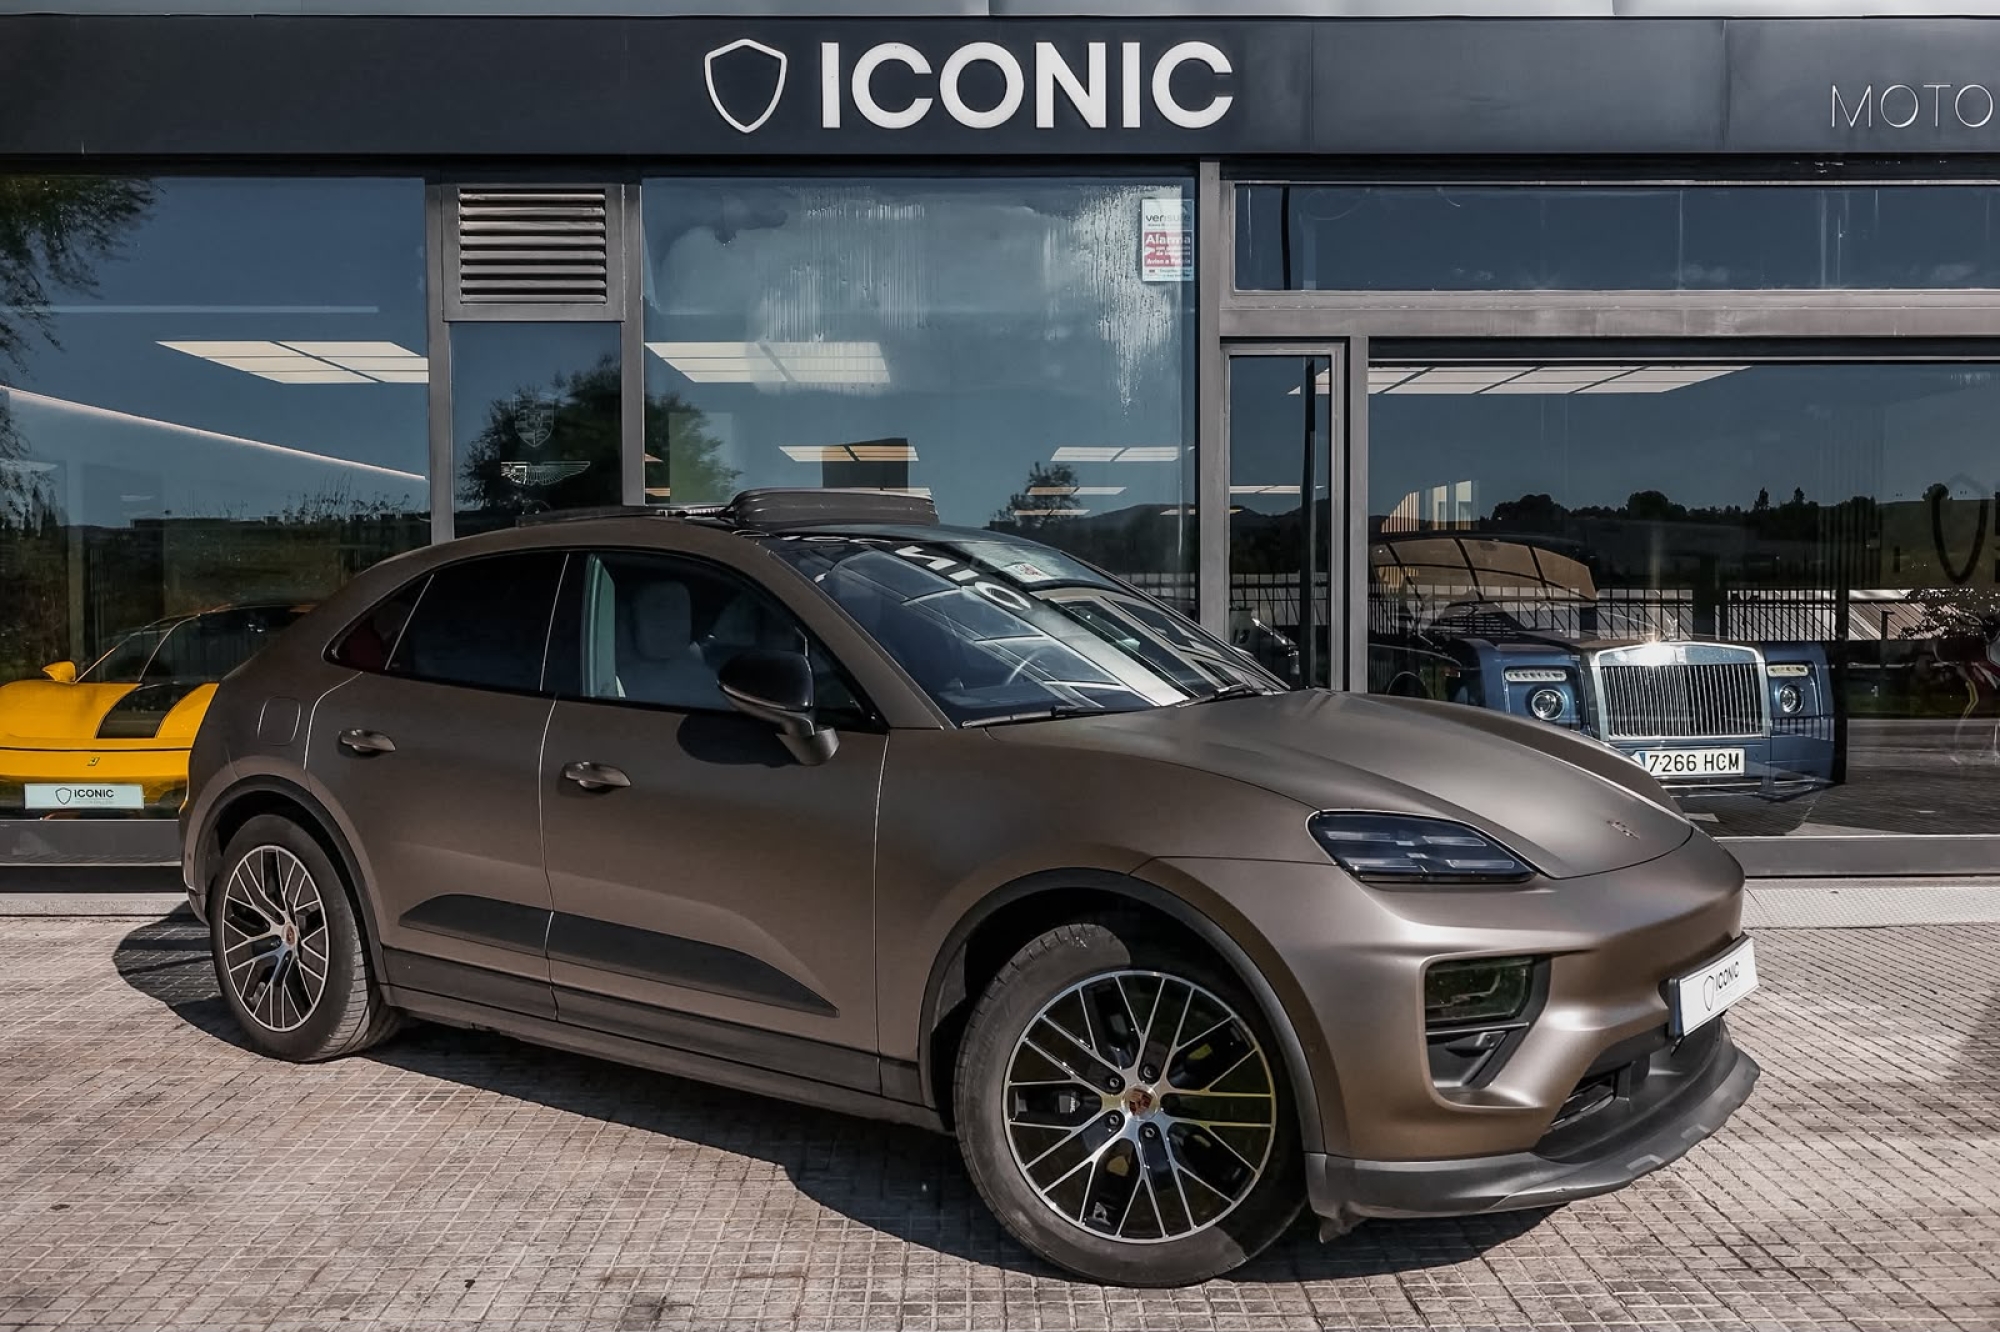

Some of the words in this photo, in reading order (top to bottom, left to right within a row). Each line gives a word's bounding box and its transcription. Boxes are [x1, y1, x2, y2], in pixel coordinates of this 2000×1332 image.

[821, 41, 1234, 130] ICONIC
[1830, 84, 1995, 129] MOTO
[1649, 754, 1697, 772] 7266
[1704, 752, 1740, 771] HCM
[74, 788, 115, 798] ICONIC
[1715, 961, 1740, 992] ICONIC
